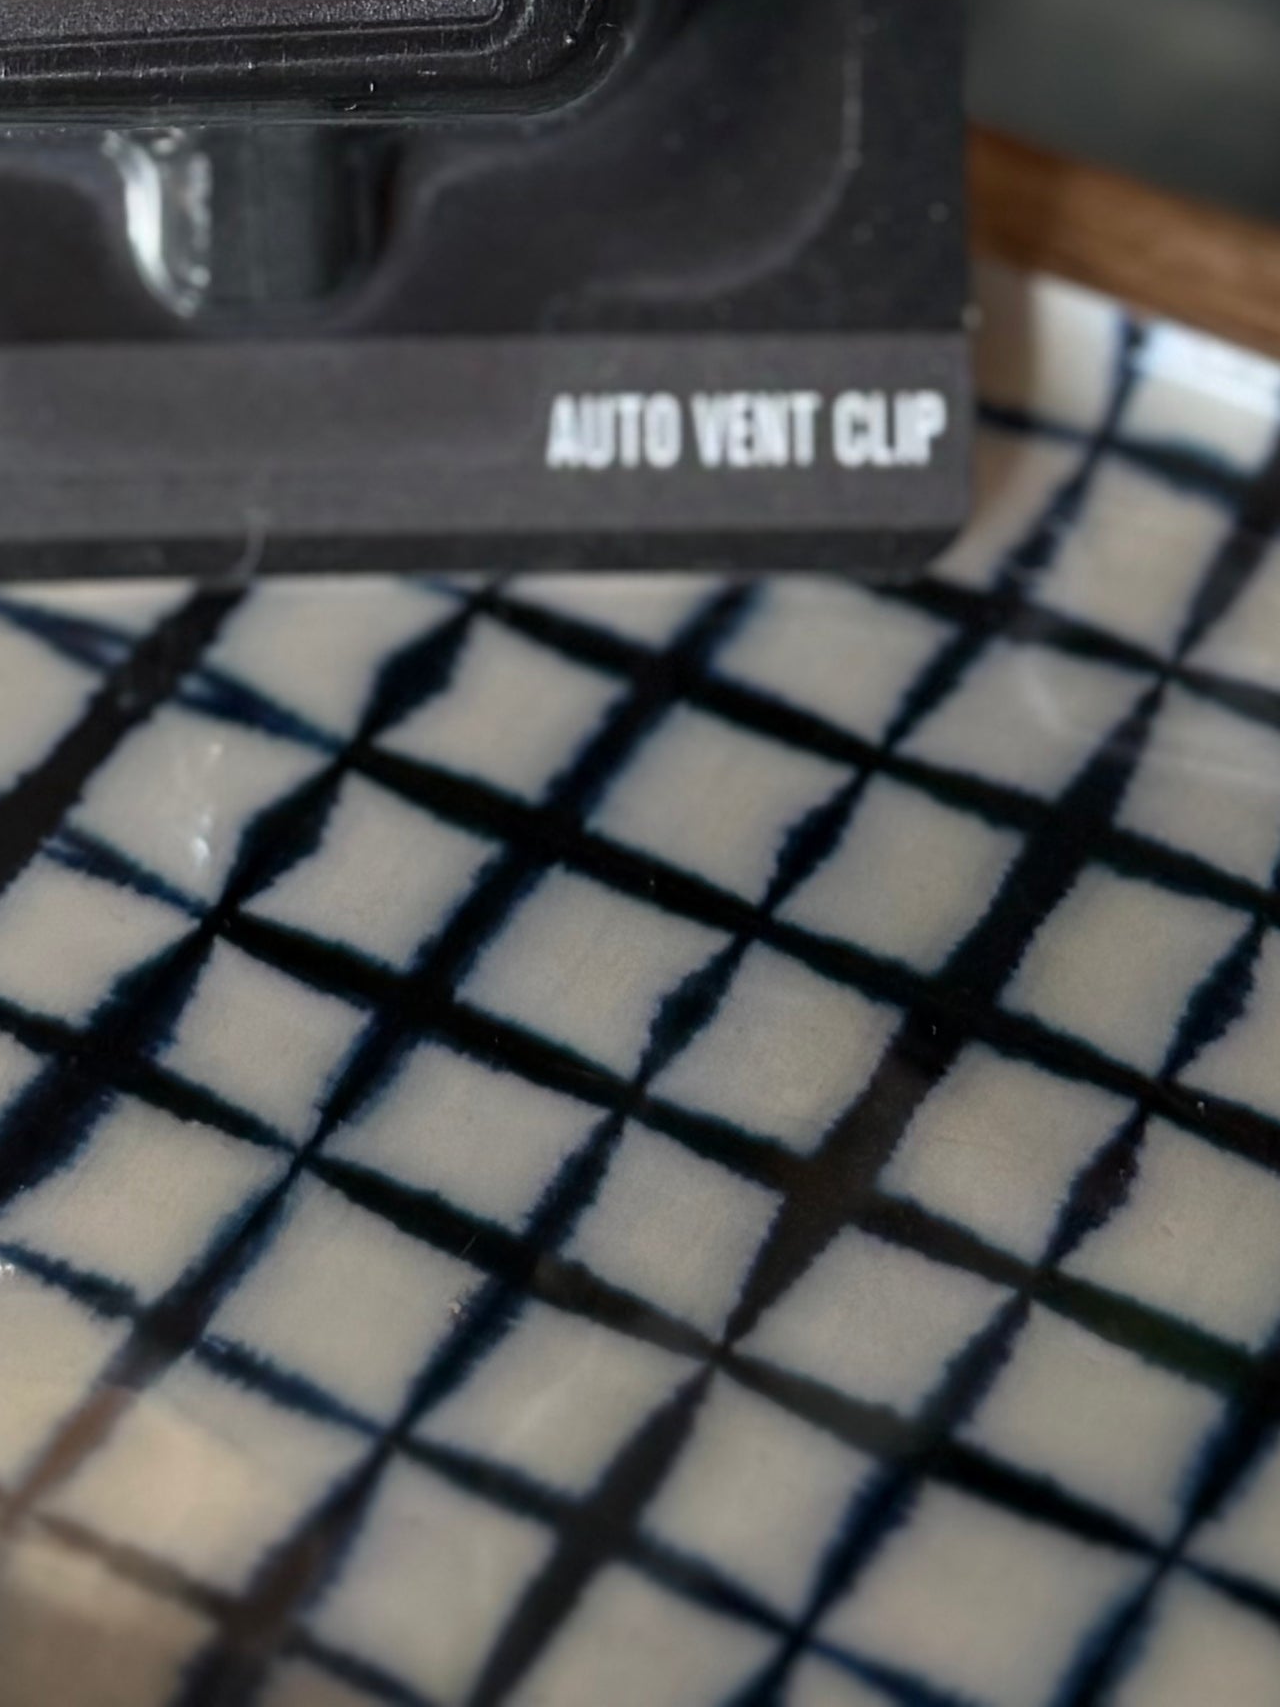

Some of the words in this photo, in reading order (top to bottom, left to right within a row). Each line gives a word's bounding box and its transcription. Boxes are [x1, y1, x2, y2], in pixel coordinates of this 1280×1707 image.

[544, 390, 684, 471] AUTO
[690, 390, 825, 470] VENT
[830, 389, 949, 470] CLIP
